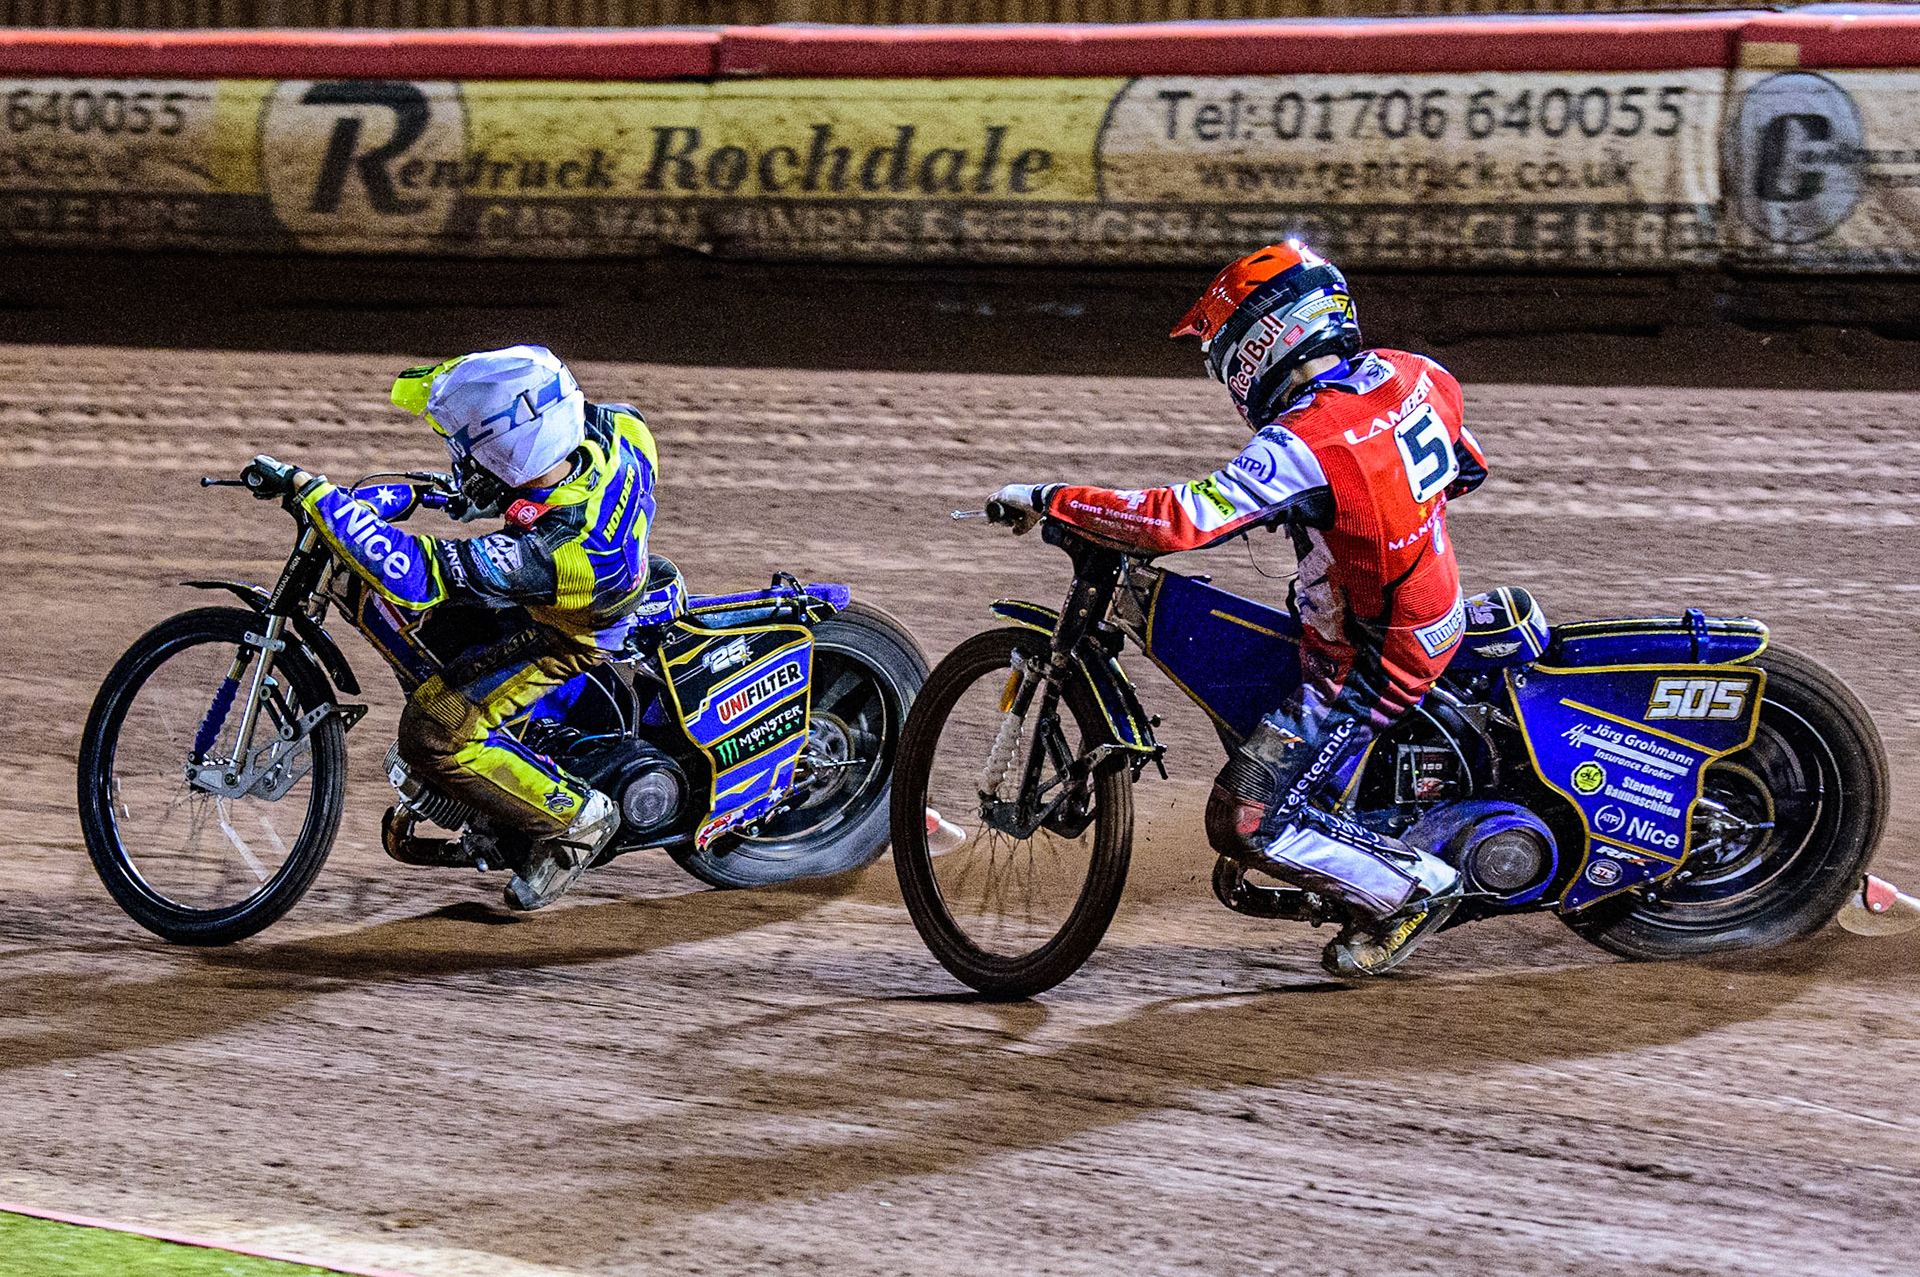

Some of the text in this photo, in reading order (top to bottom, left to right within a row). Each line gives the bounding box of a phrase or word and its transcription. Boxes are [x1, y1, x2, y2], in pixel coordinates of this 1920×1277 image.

[7, 89, 188, 135] 640055
[1272, 89, 1449, 142] 01706
[1467, 86, 1686, 138] 640055
[639, 122, 1055, 194] Rochdale
[1233, 455, 1267, 477] ATPI
[1402, 414, 1449, 491] 5
[602, 463, 636, 543] HOLDER
[1069, 500, 1103, 515] Grant
[332, 500, 411, 580] Nice
[718, 662, 803, 722] UNIFILTER
[1645, 679, 1750, 721] 505
[738, 705, 804, 747] MONSTER
[748, 718, 801, 752] ENERGY
[1592, 724, 1695, 767] Jörg Grohmann
[1276, 717, 1356, 816] Teletecnica
[1593, 749, 1675, 781] Insurance Broker
[1604, 784, 1681, 819] Baumaschinen
[1621, 776, 1675, 804] Sternberg
[1625, 816, 1680, 849] Nice
